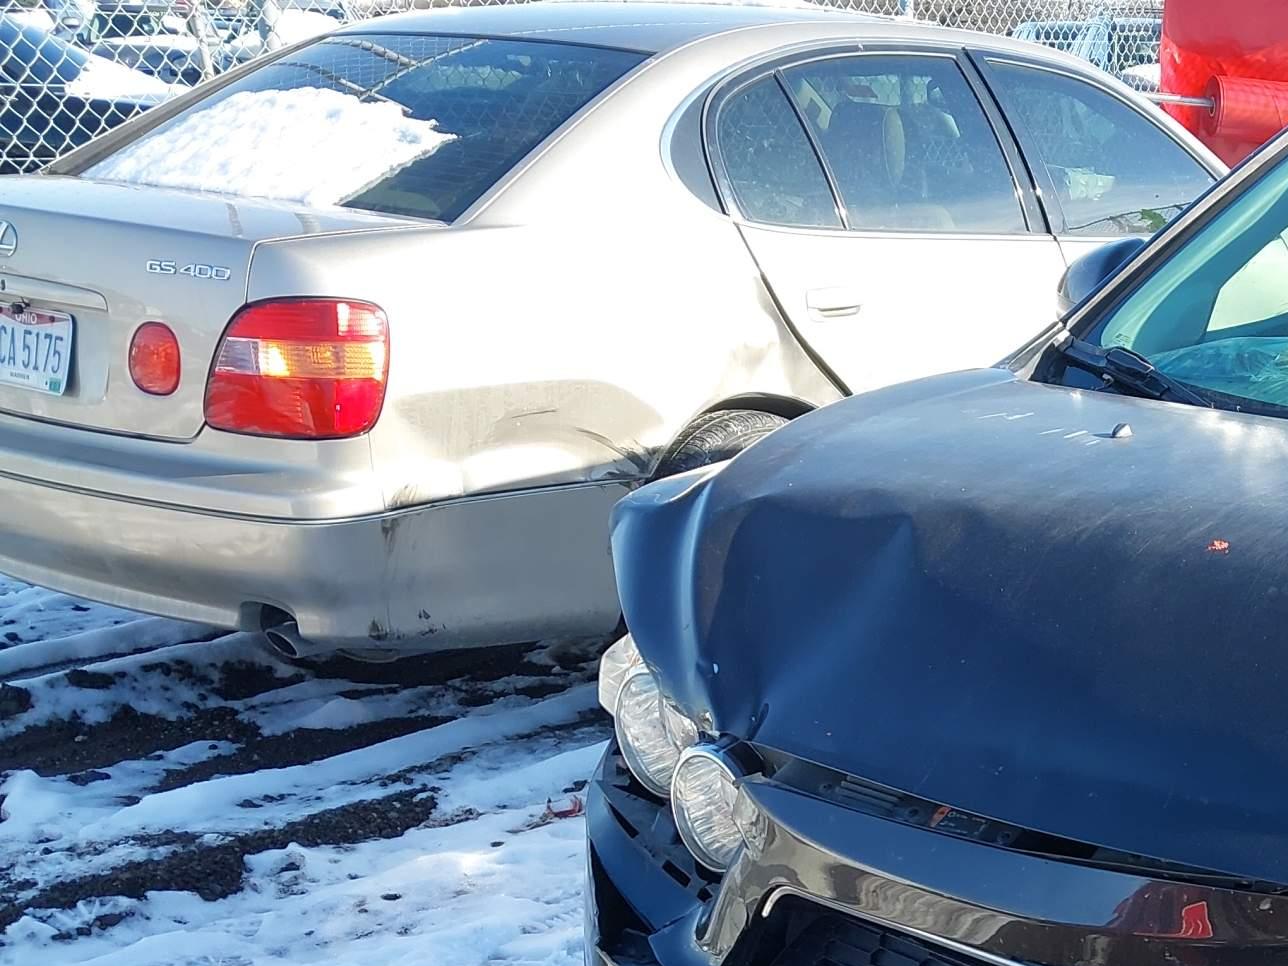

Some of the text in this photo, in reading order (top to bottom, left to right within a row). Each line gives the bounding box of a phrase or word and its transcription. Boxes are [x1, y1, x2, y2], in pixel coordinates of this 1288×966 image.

[146, 260, 232, 281] GS 400
[22, 329, 64, 374] 5175
